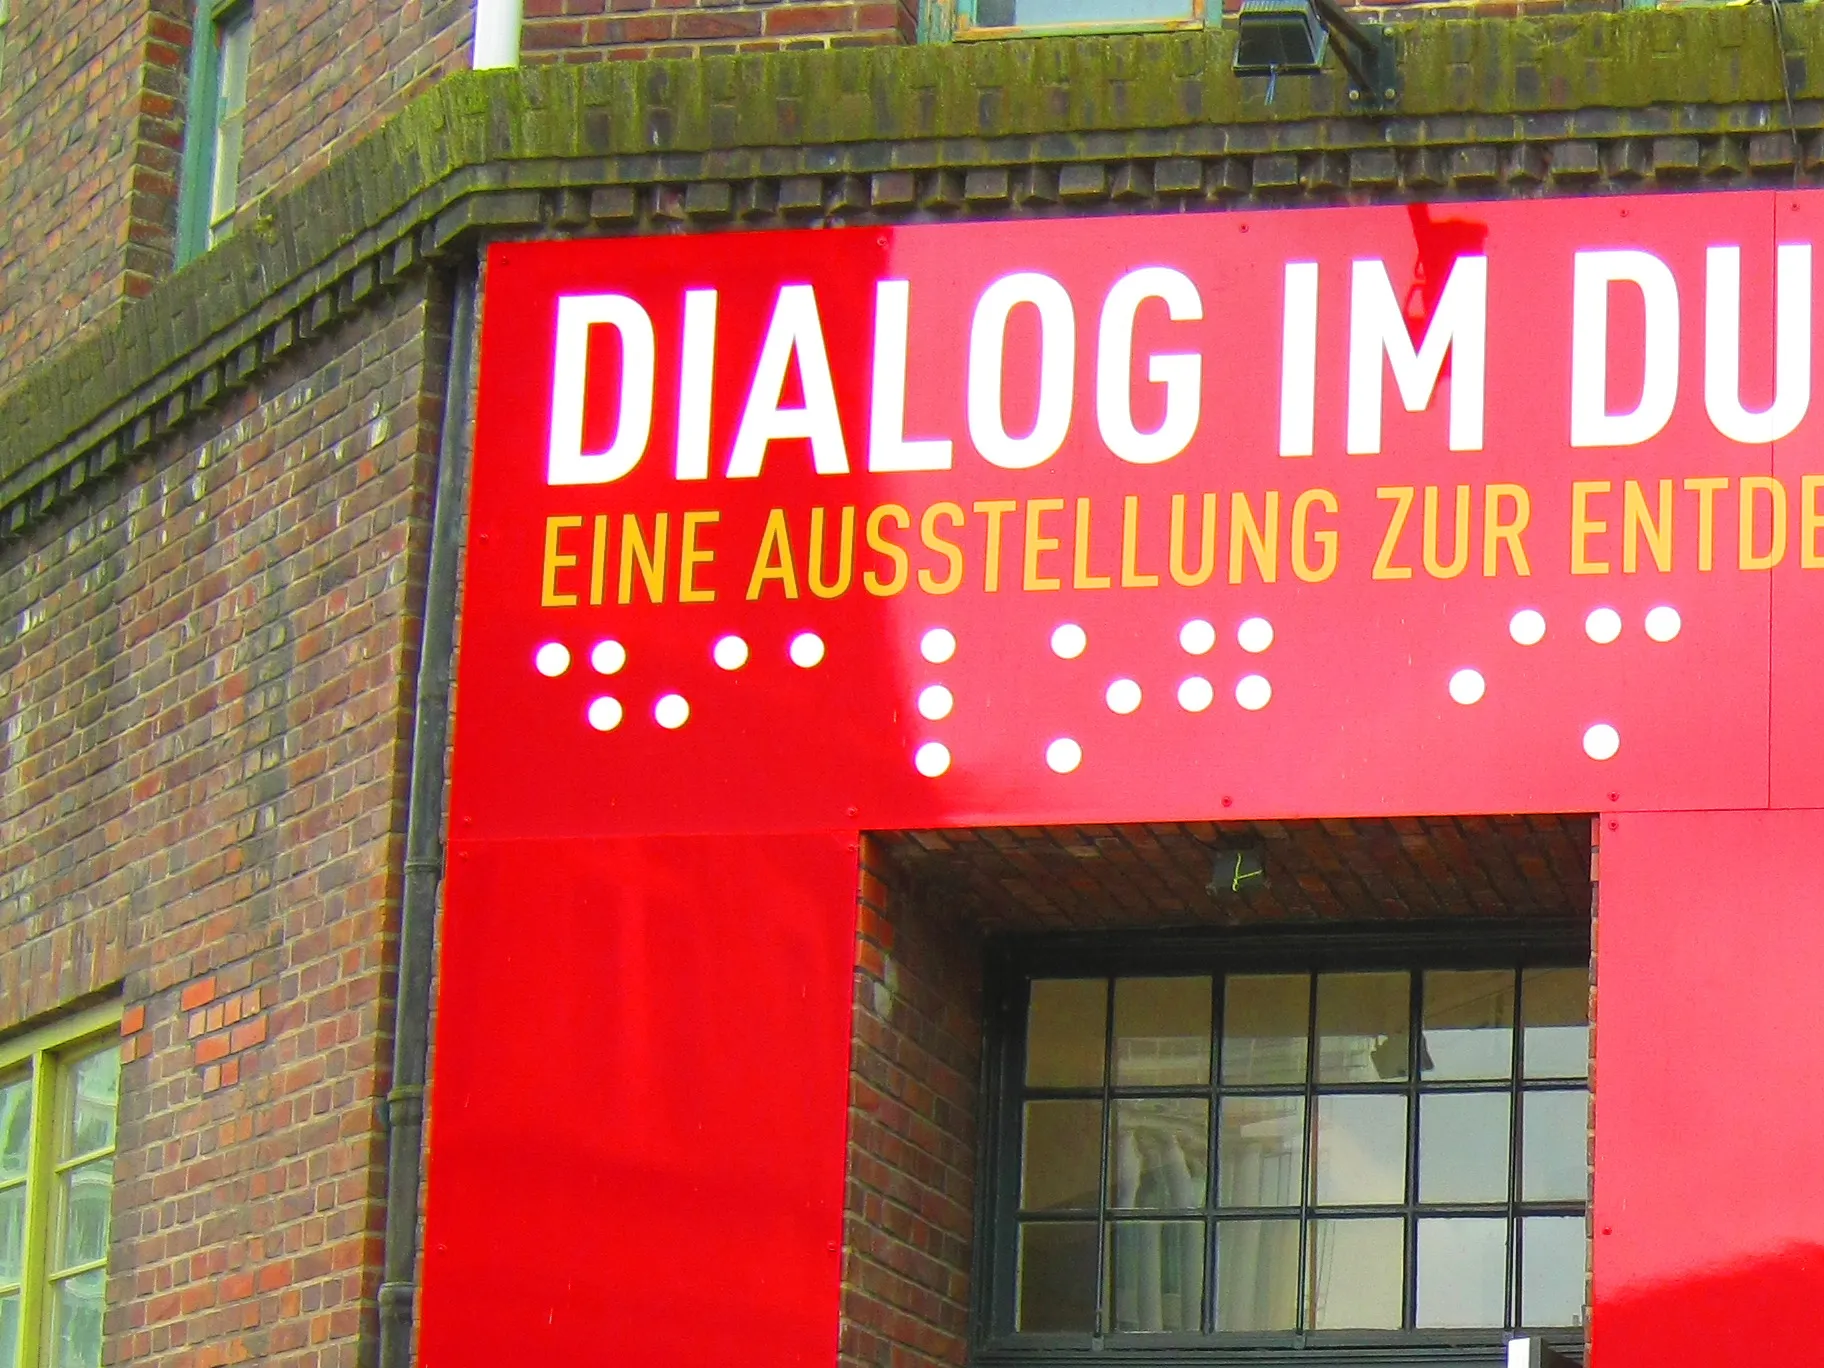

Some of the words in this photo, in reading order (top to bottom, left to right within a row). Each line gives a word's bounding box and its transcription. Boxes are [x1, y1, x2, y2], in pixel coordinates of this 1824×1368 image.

[549, 267, 1202, 484] DIALOG
[1280, 256, 1487, 456] IM
[542, 512, 719, 606] EINE
[747, 489, 1338, 599] AUSSTELLUNG
[1373, 484, 1530, 579] ZUR
